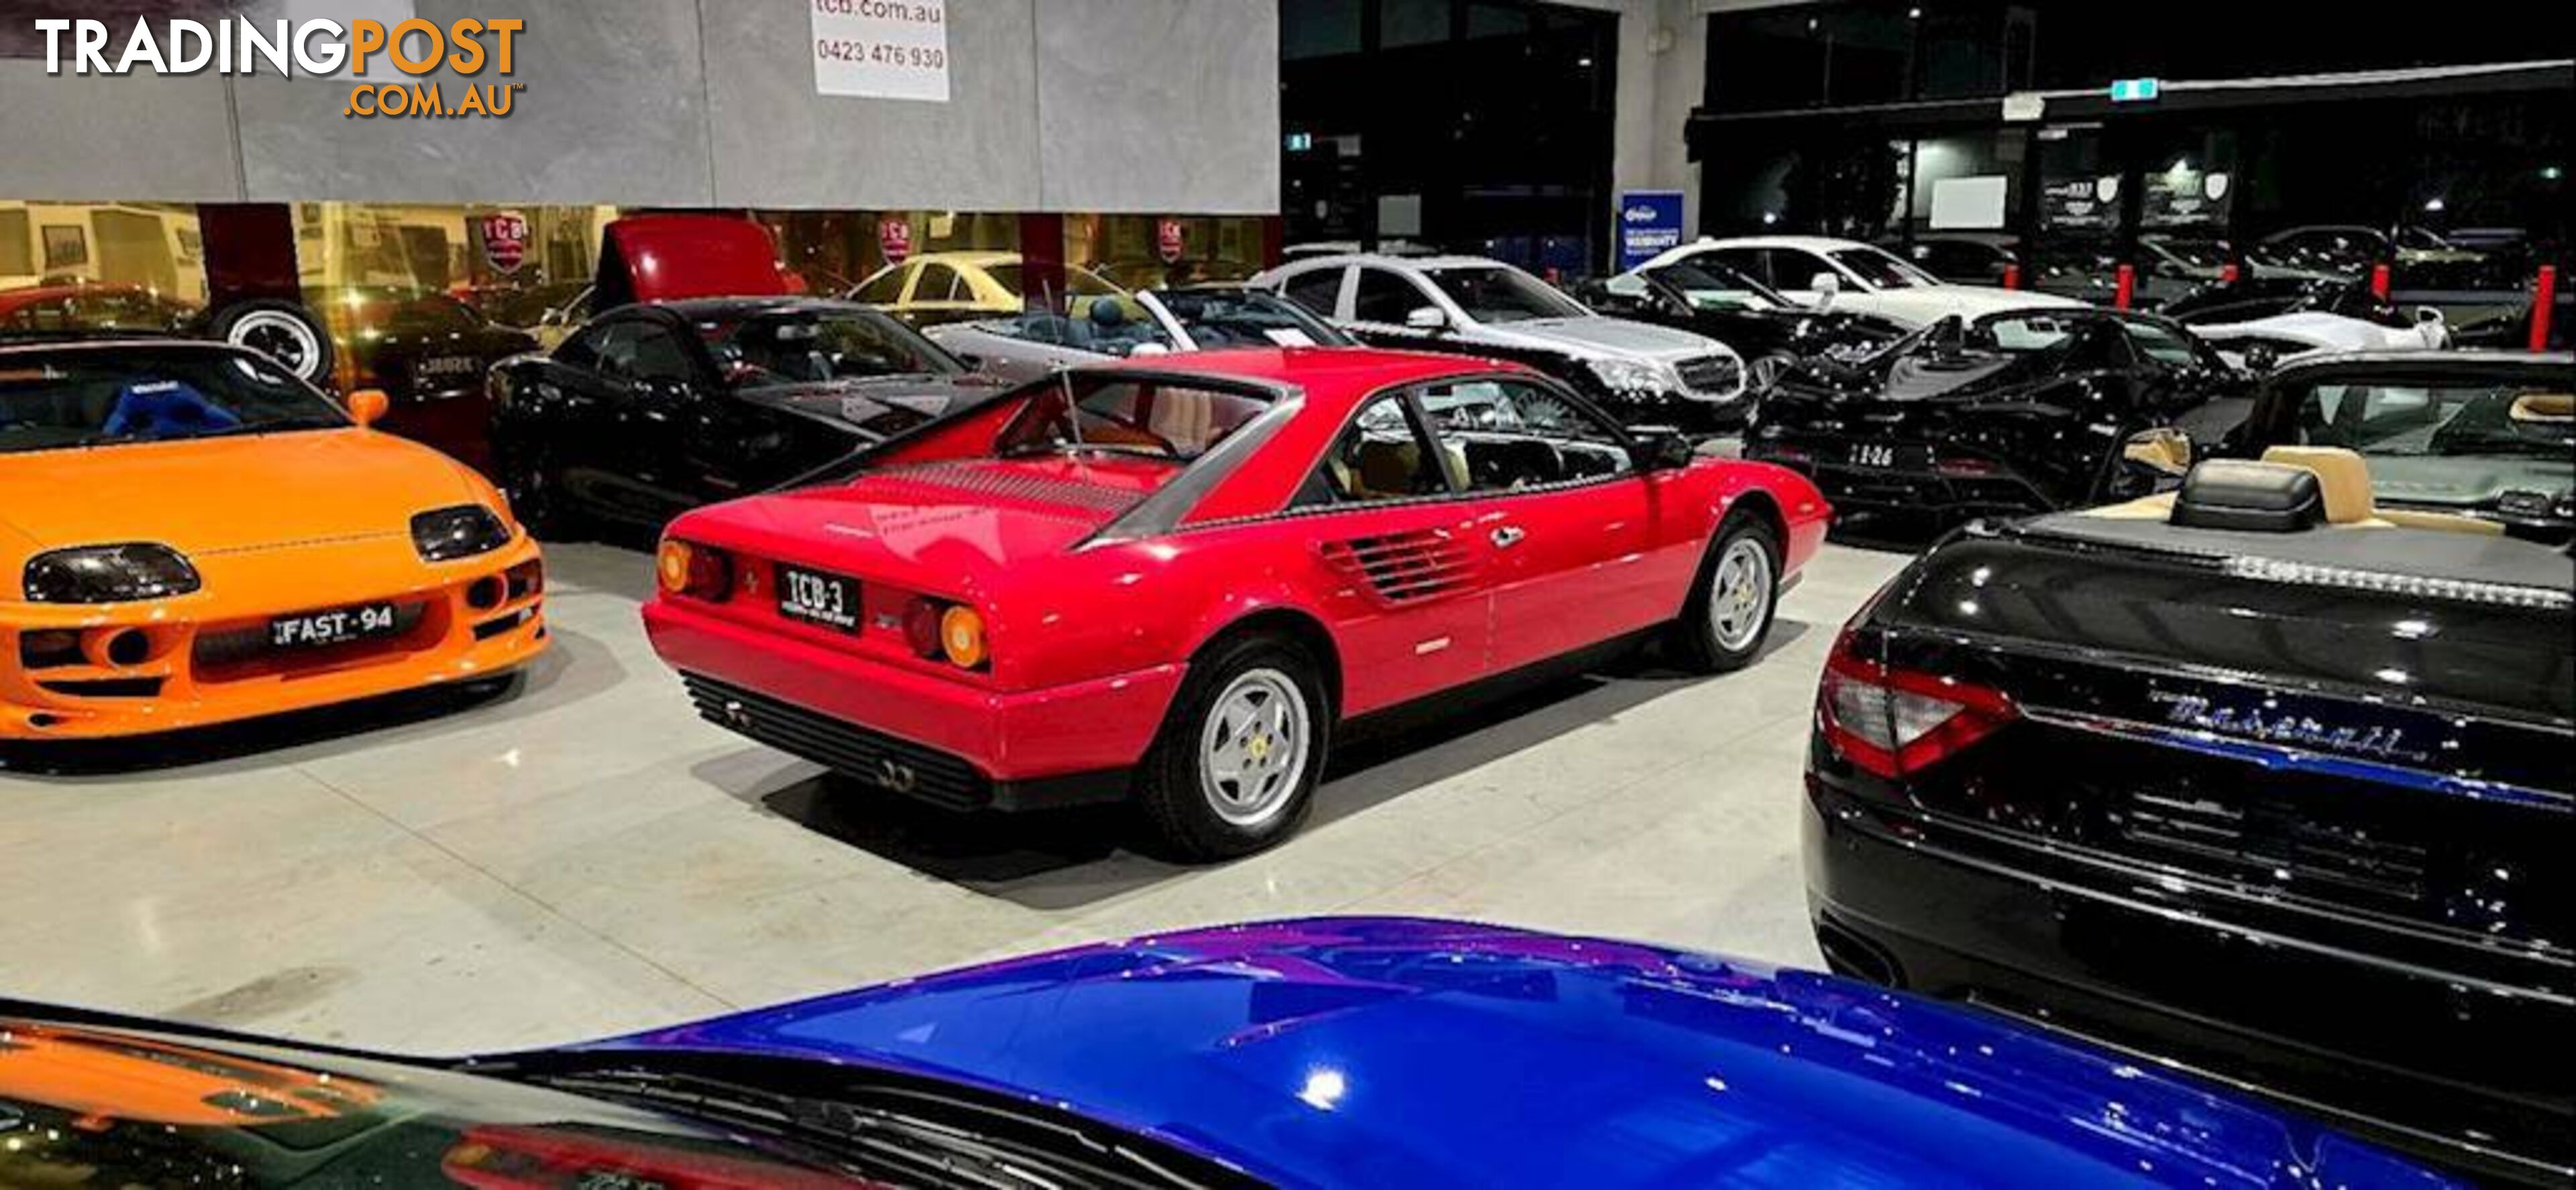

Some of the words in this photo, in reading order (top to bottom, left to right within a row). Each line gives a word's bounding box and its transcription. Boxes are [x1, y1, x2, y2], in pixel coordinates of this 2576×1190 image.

[818, 39, 865, 62] 0423
[871, 43, 906, 66] 476
[910, 46, 944, 69] 930
